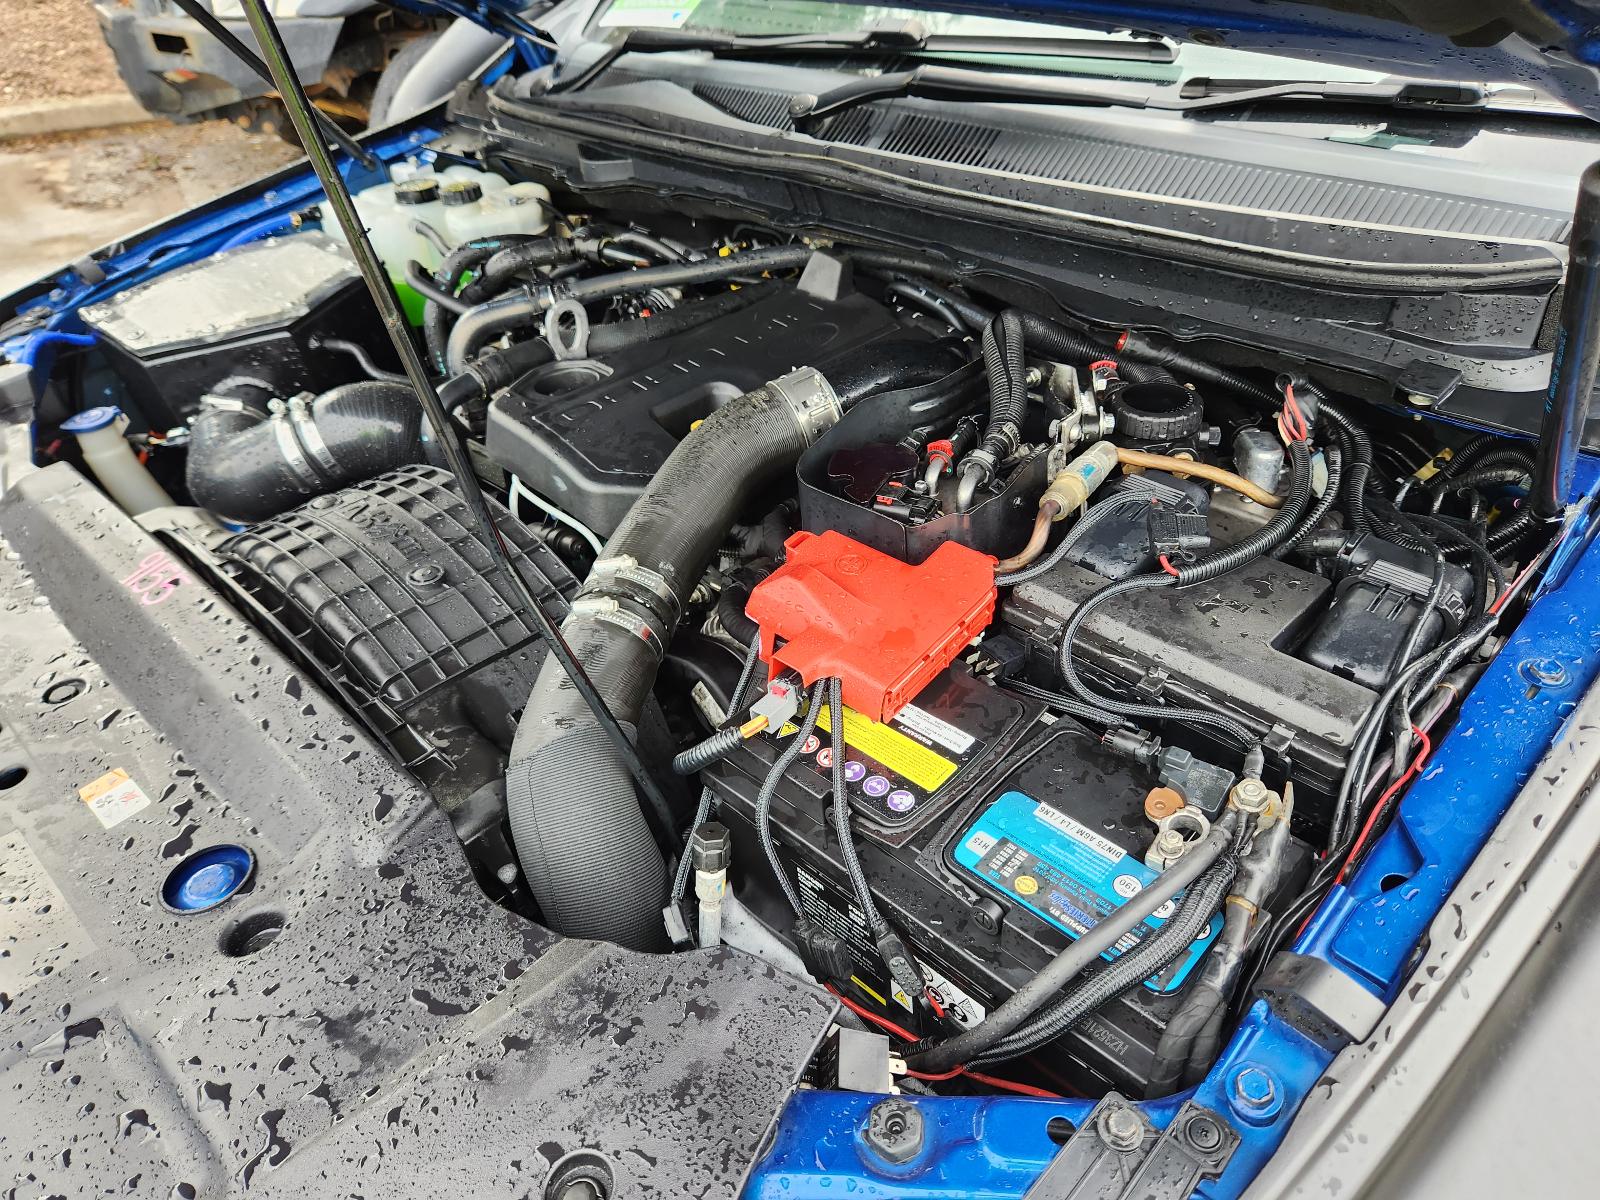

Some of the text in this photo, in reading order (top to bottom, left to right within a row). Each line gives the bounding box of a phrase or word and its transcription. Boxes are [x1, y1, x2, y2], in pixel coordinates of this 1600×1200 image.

[898, 725, 933, 746] WARRANTY
[1075, 828, 1096, 841] AGM
[1096, 840, 1123, 859] DIN75
[1119, 879, 1136, 893] 190
